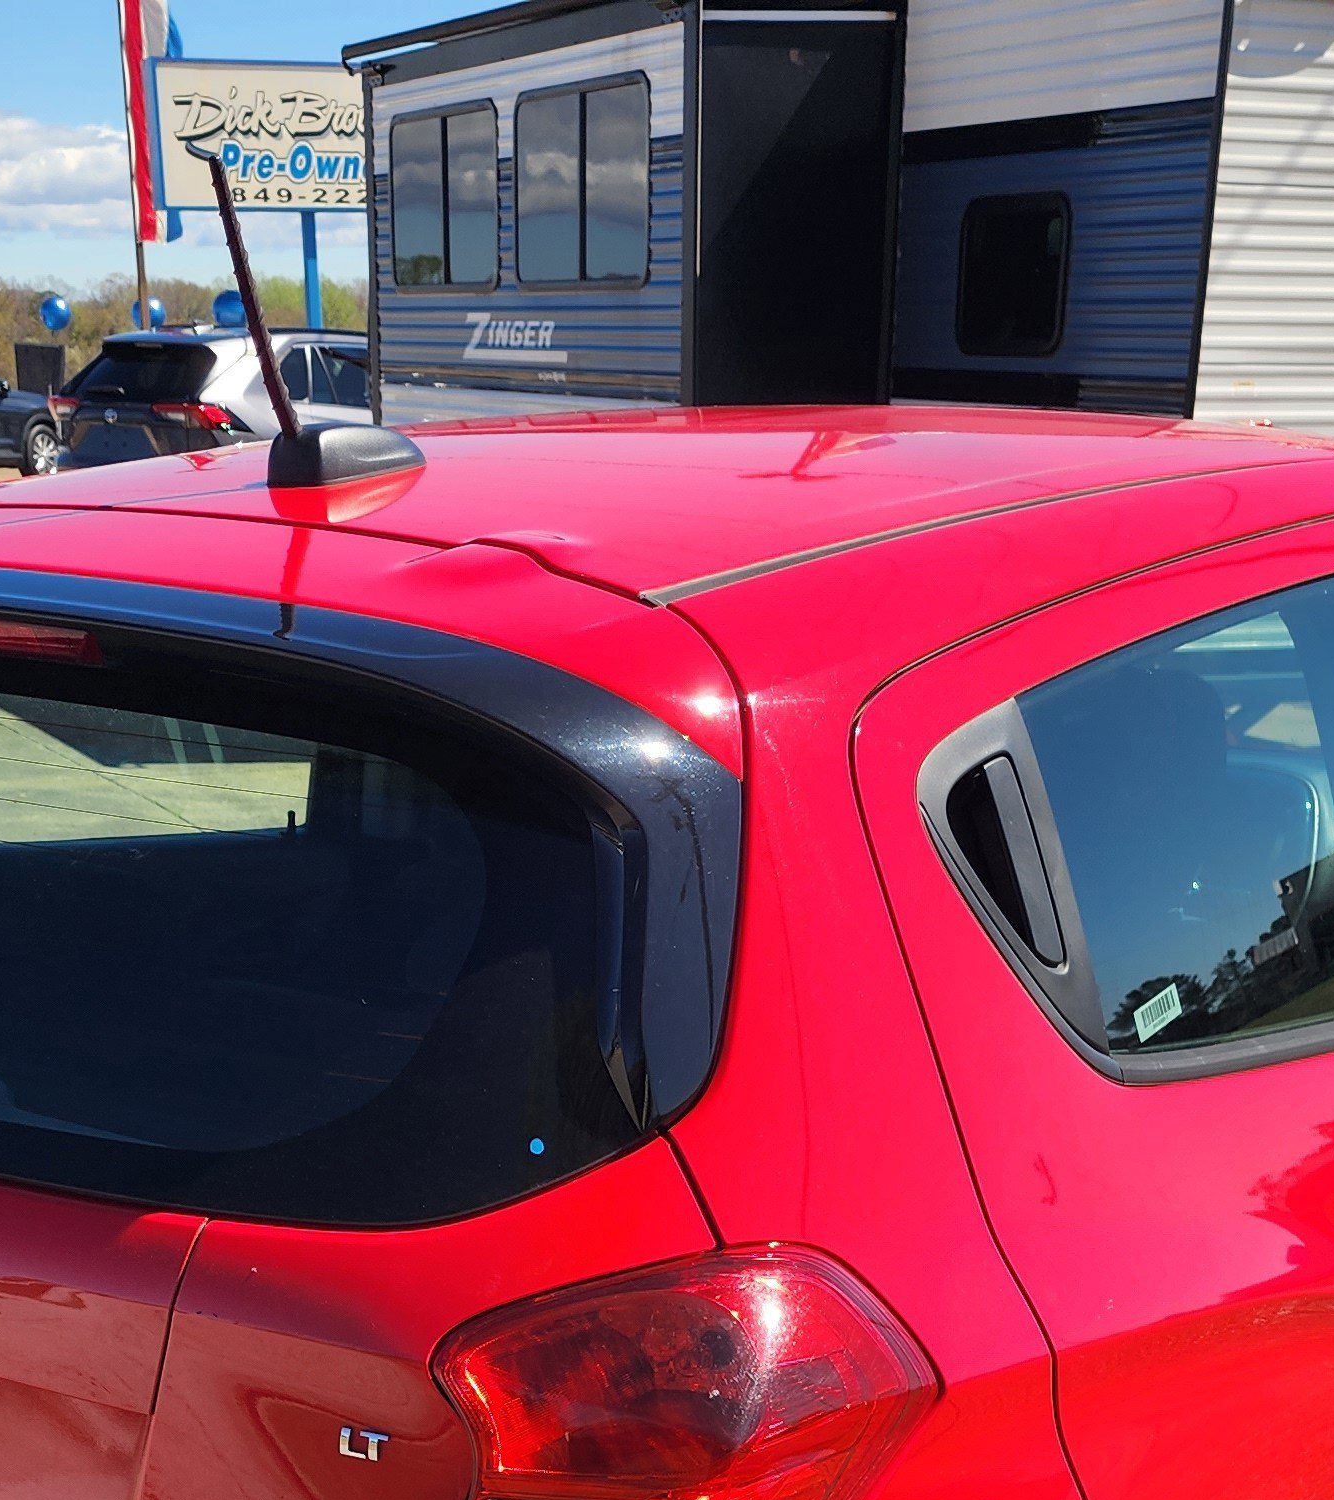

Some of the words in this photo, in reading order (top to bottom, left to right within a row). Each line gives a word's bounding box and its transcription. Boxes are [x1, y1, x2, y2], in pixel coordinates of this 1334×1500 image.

[172, 86, 279, 141] Dick
[220, 139, 366, 184] Pre-Own
[463, 312, 567, 363] ZINGER
[339, 1426, 389, 1462] LT
